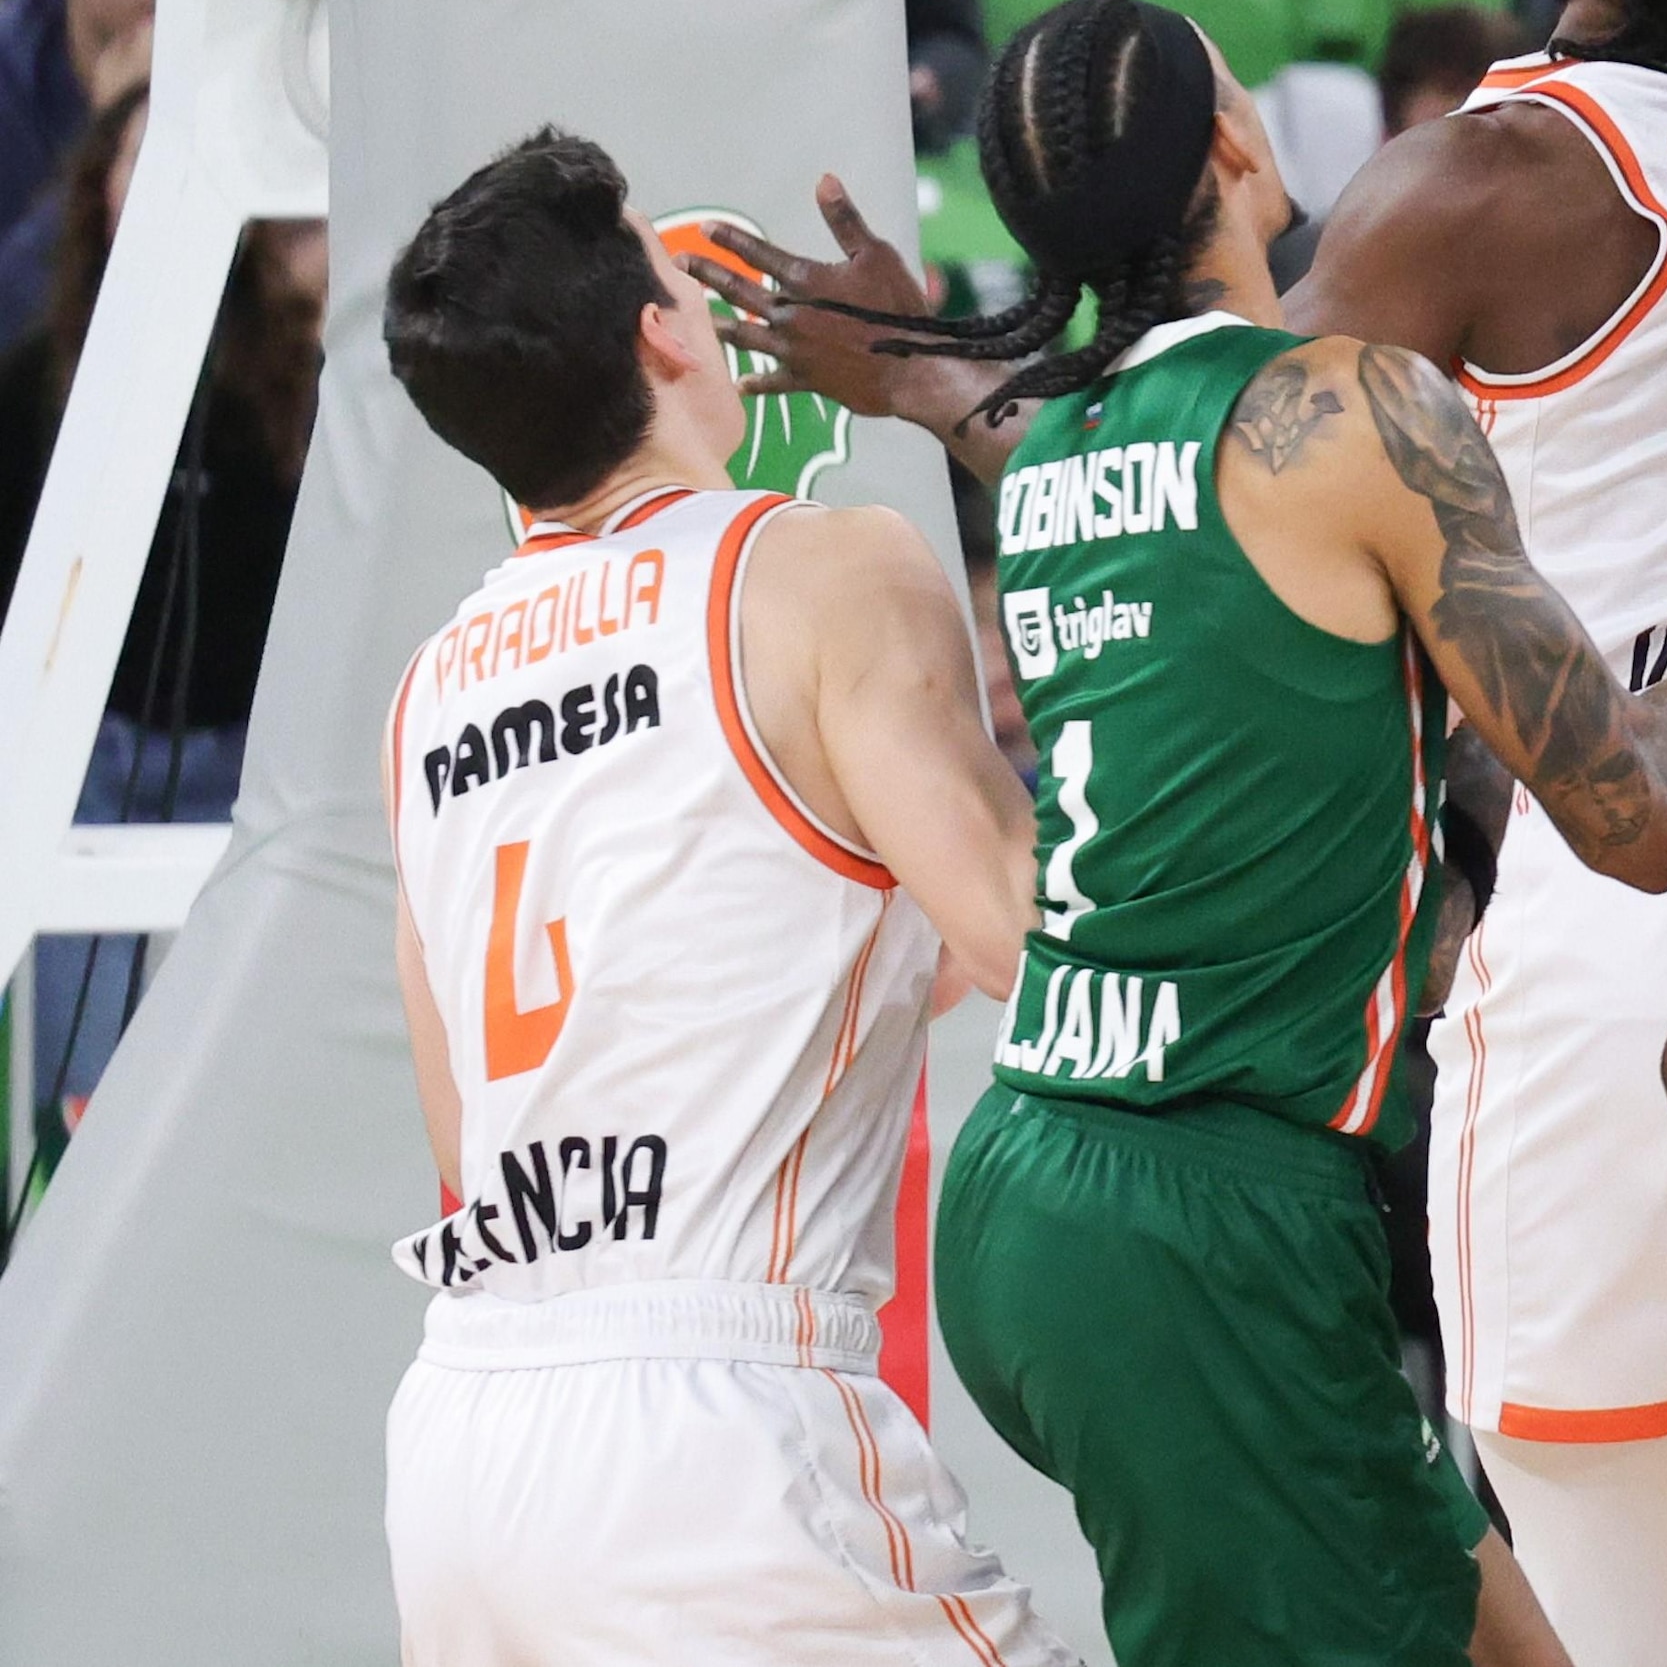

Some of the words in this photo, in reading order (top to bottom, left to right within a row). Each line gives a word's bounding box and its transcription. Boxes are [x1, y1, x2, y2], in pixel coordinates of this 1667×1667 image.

[434, 547, 665, 705] PRADILLA
[1054, 589, 1153, 660] triglav
[423, 663, 661, 819] PAMESA
[1041, 719, 1099, 942] 1
[483, 840, 575, 1082] 4
